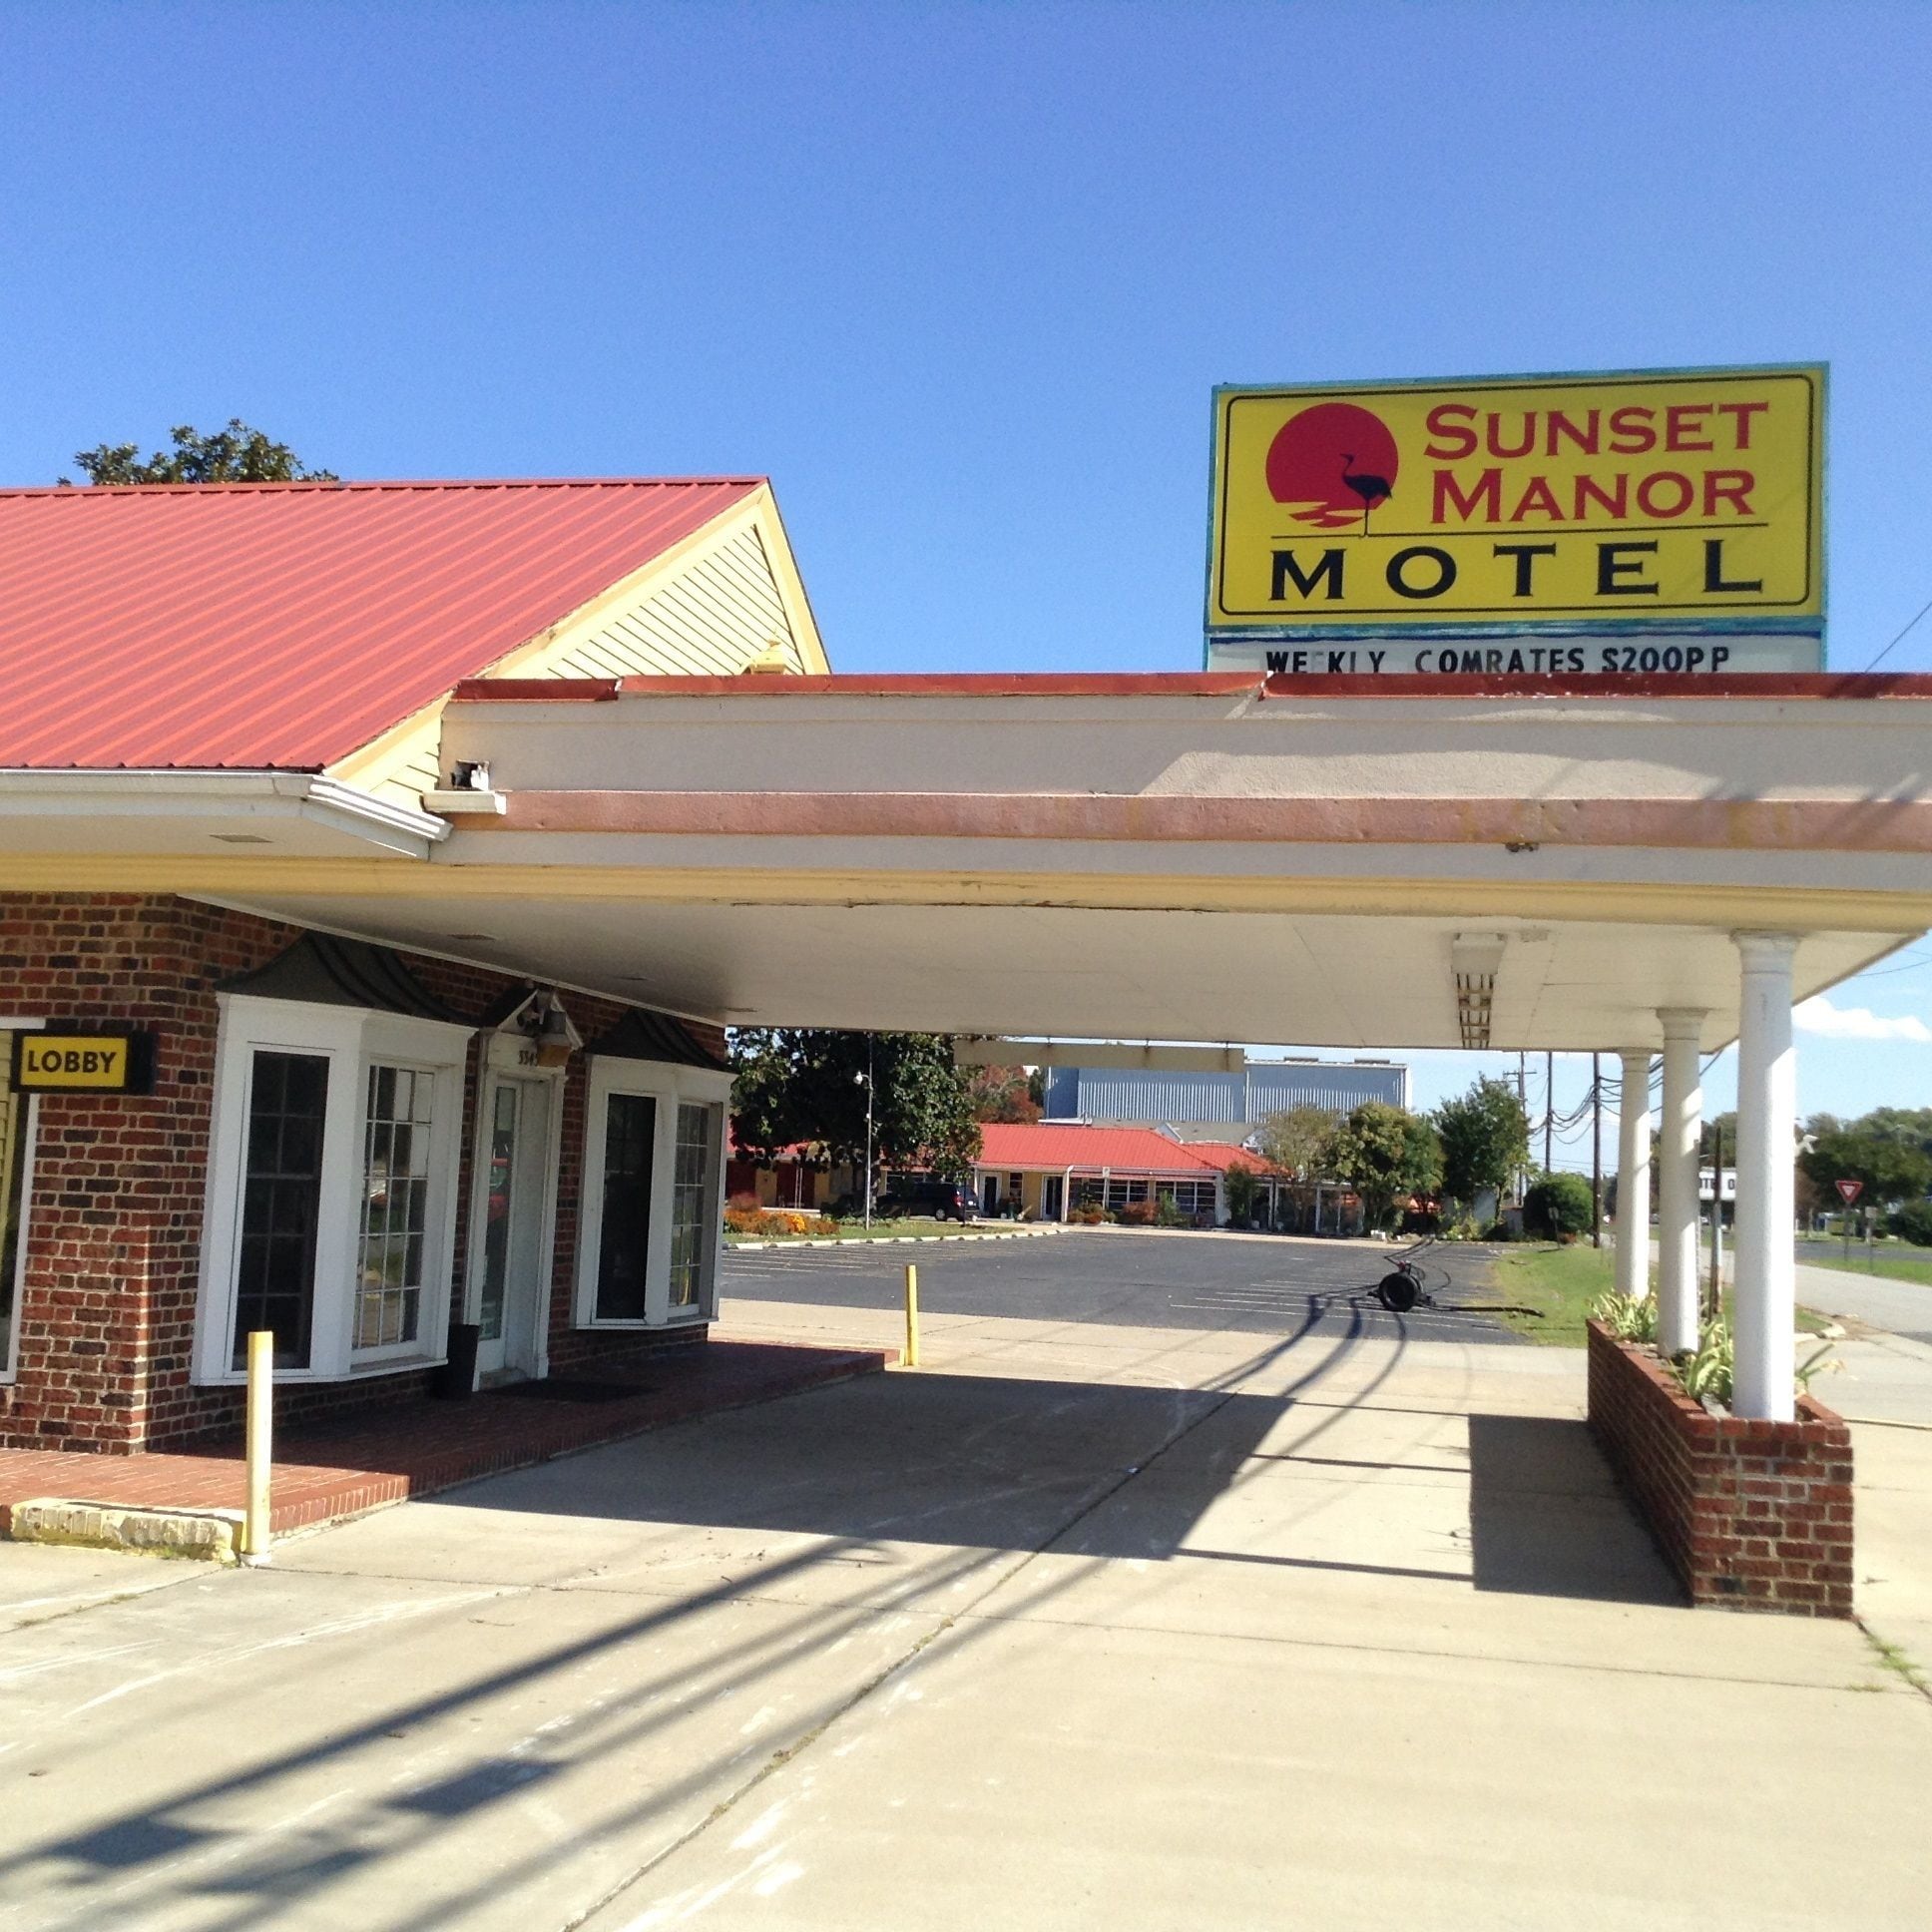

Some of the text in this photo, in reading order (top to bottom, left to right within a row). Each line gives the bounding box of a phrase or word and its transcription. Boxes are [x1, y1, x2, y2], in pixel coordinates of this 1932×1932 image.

[1424, 401, 1769, 460] SUNSET
[1431, 467, 1756, 524] MANOR
[1268, 539, 1764, 601] MOTEL
[27, 1050, 117, 1073] LOBBY
